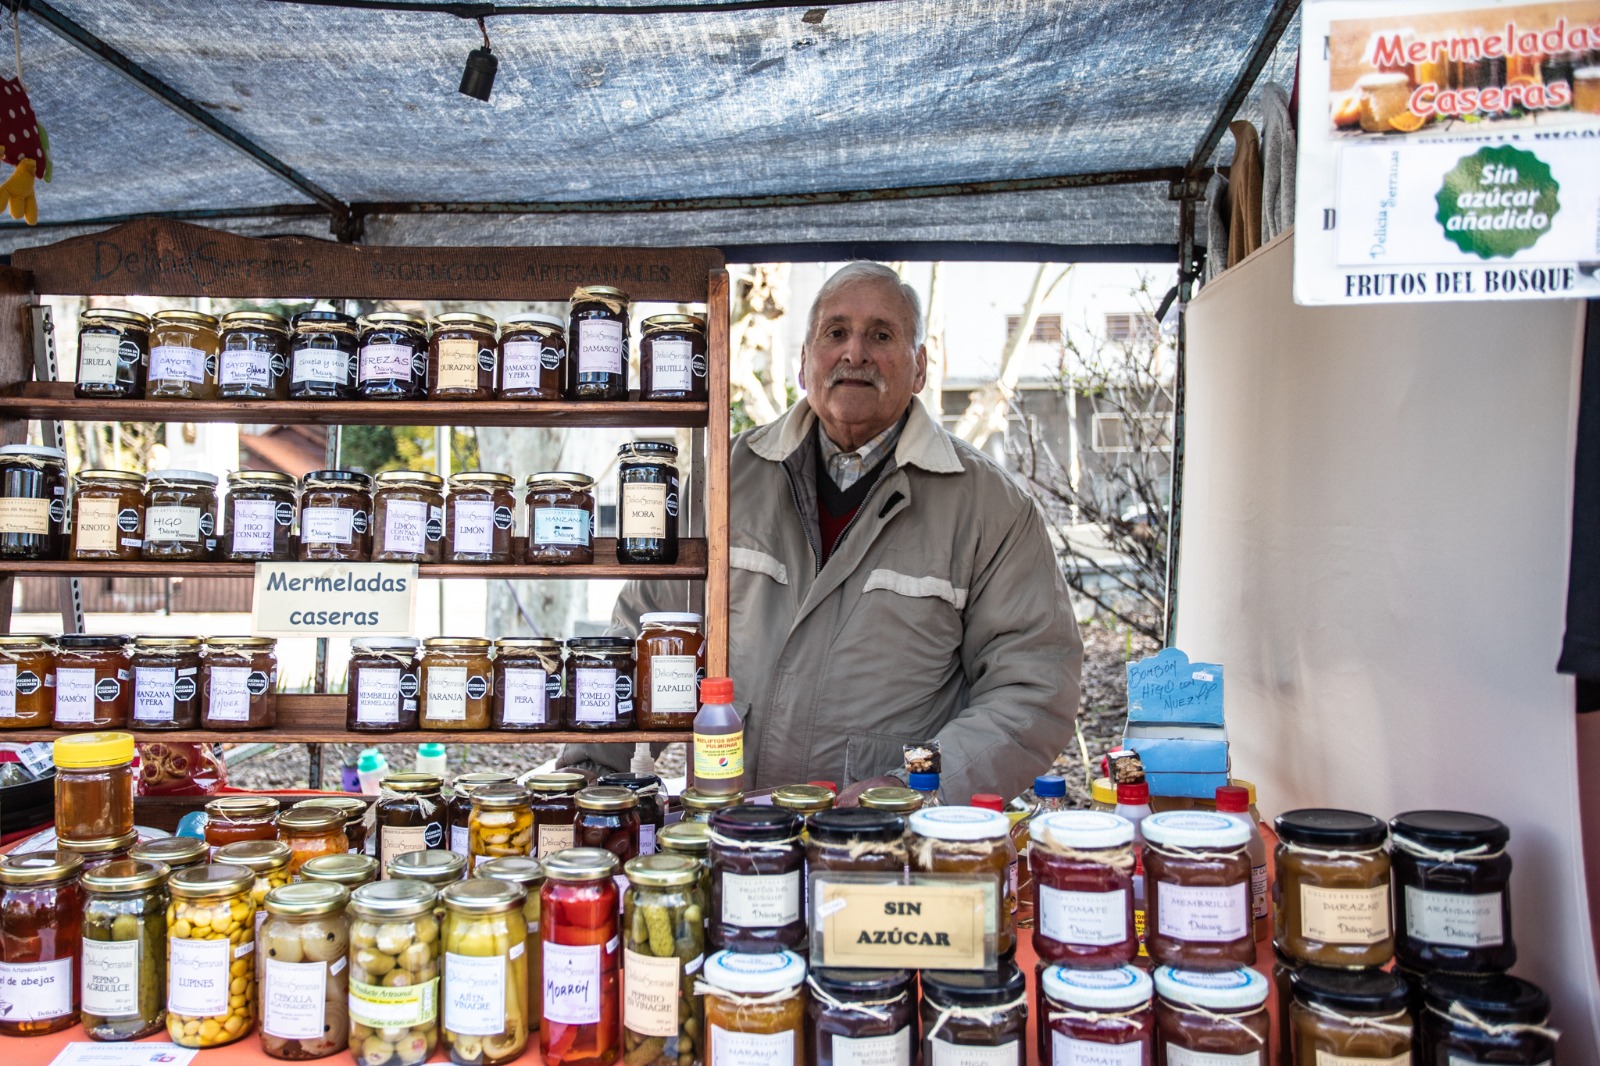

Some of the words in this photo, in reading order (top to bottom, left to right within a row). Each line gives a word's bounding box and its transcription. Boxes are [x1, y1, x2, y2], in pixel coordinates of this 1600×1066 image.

[1409, 80, 1572, 117] Caseras
[1479, 163, 1519, 185] Sin
[1457, 186, 1541, 209] azúcar
[1446, 209, 1549, 232] añadido
[526, 262, 671, 284] ARTESANALES
[1345, 272, 1427, 296] FRUTOS
[1435, 270, 1476, 294] DEL
[1484, 268, 1575, 293] BOSQUE
[582, 345, 619, 353] DAMASCO
[82, 358, 112, 366] CIRUELA
[656, 365, 688, 373] FRUTILLA
[81, 523, 110, 531] KINOTO
[154, 517, 182, 526] HIGO
[394, 522, 417, 530] LIMÓN
[460, 526, 485, 534] LIMÓN
[266, 571, 406, 592] Mermeladas
[289, 611, 379, 625] caseras
[58, 694, 87, 702] MAMÓN
[429, 693, 463, 701] NARANJA
[514, 696, 534, 704] PERA
[884, 901, 922, 915] SIN
[1171, 898, 1236, 909] MEMBRILLO
[1323, 902, 1380, 912] DURAZNO
[1063, 905, 1108, 914] TOMATE
[856, 928, 951, 947] AZÚCAR
[7, 977, 17, 986] de
[21, 976, 55, 986] abejas
[92, 975, 120, 983] PEPINO
[179, 977, 215, 988] LUPINES
[86, 983, 131, 993] AGRIDULCE
[380, 988, 413, 997] Artesanal
[274, 992, 313, 1003] CEBOLLA
[631, 990, 665, 1003] PEPINITO
[635, 1001, 673, 1013] VINAGRE
[729, 1048, 778, 1061] NARANJA
[1075, 1054, 1123, 1066] TOMATE
